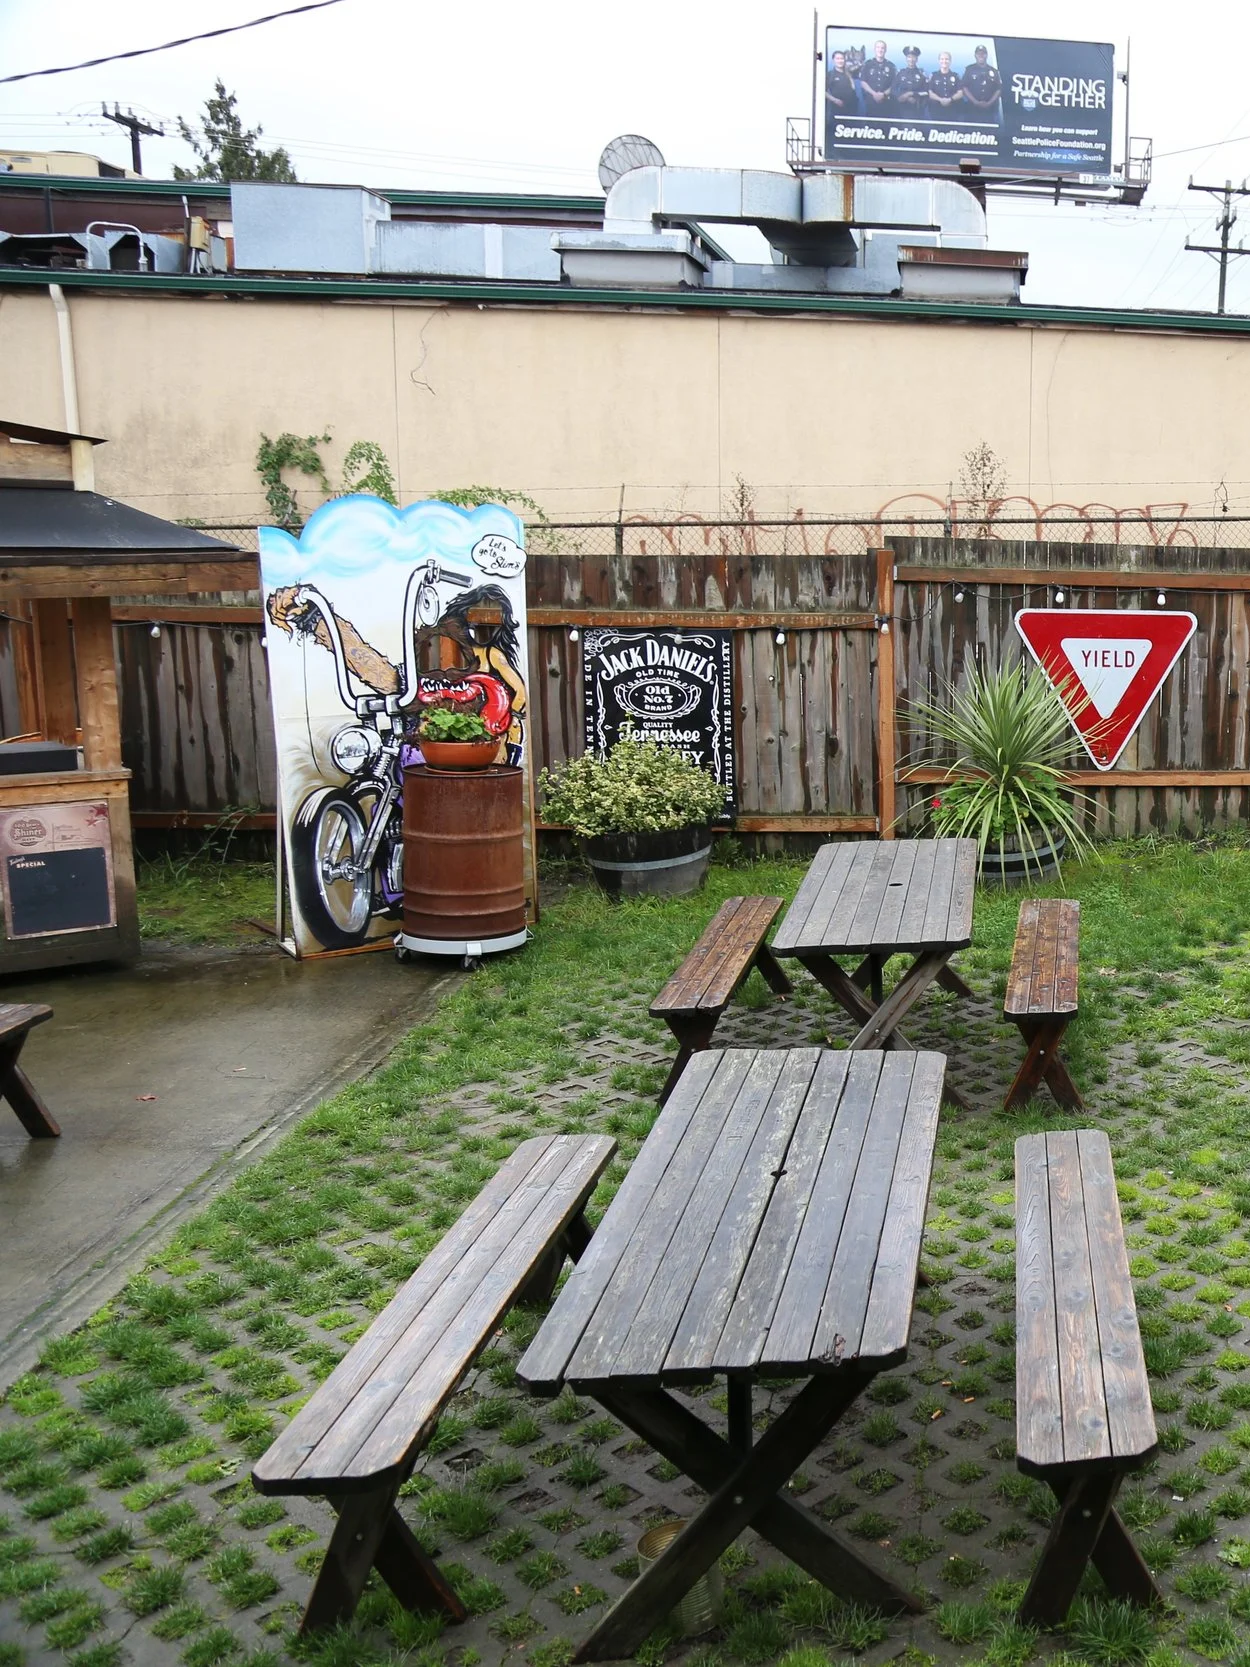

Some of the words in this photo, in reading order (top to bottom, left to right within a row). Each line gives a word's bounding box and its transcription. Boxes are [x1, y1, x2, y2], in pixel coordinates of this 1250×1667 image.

[1012, 73, 1105, 96] STANDING
[834, 124, 885, 139] Service.
[888, 127, 925, 142] Pride.
[928, 129, 998, 145] Dedication.
[1021, 124, 1038, 132] Learn
[1075, 128, 1098, 136] support
[1012, 136, 1106, 151] SeattlePoliceFoundation.org
[1013, 150, 1051, 160] Partnership
[1051, 152, 1062, 160] for
[1067, 153, 1081, 161] Safe
[1082, 154, 1105, 162] Seattle
[583, 641, 593, 681] MADE
[598, 646, 646, 681] JACK
[645, 639, 718, 683] DANIEL'S
[1081, 650, 1135, 668] YIELD
[635, 668, 654, 678] OLD
[657, 668, 680, 679] TIME
[722, 640, 732, 706] DISTILLERY
[585, 690, 593, 706] IN
[645, 685, 670, 695] Old
[642, 721, 674, 729] QUALITY
[724, 710, 732, 732] THE
[618, 721, 701, 743] Tennessee
[724, 736, 732, 749] AT
[725, 754, 733, 802] BOTTLED
[16, 861, 46, 869] SPECIAL
